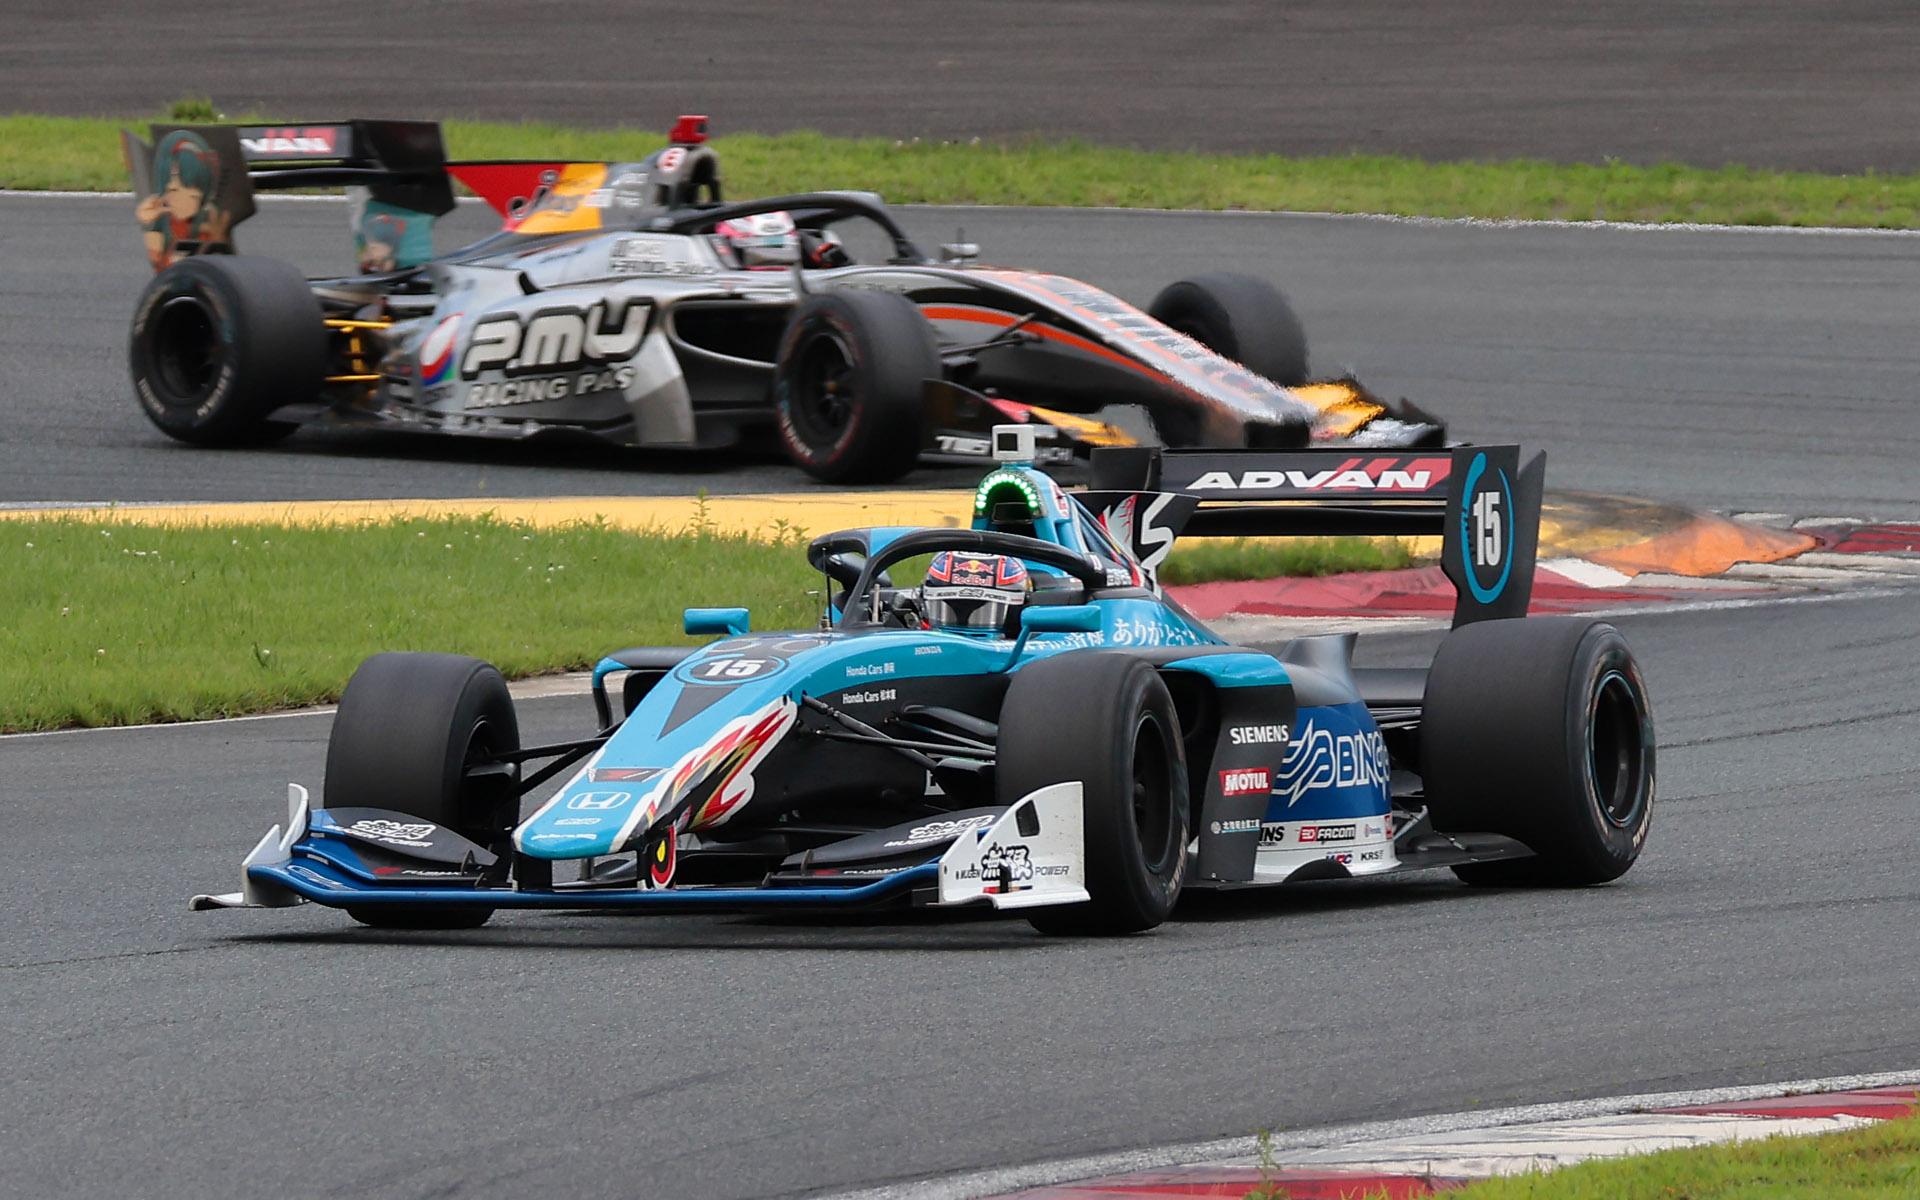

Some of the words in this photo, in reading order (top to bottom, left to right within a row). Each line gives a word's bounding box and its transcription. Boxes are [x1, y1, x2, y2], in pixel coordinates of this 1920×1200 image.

[464, 378, 569, 409] RACING
[1185, 470, 1432, 489] ADVAN
[1473, 492, 1502, 566] 15
[915, 646, 942, 655] HONDA
[705, 659, 767, 677] 15
[846, 665, 867, 677] Honda
[868, 664, 883, 675] Cars
[842, 692, 864, 704] Honda
[864, 691, 880, 702] Cars
[1230, 725, 1289, 744] SIEMENS
[1225, 772, 1268, 791] MOTUL
[1317, 827, 1355, 840] FACOM
[381, 836, 434, 848] POWER
[1034, 865, 1071, 877] POWER
